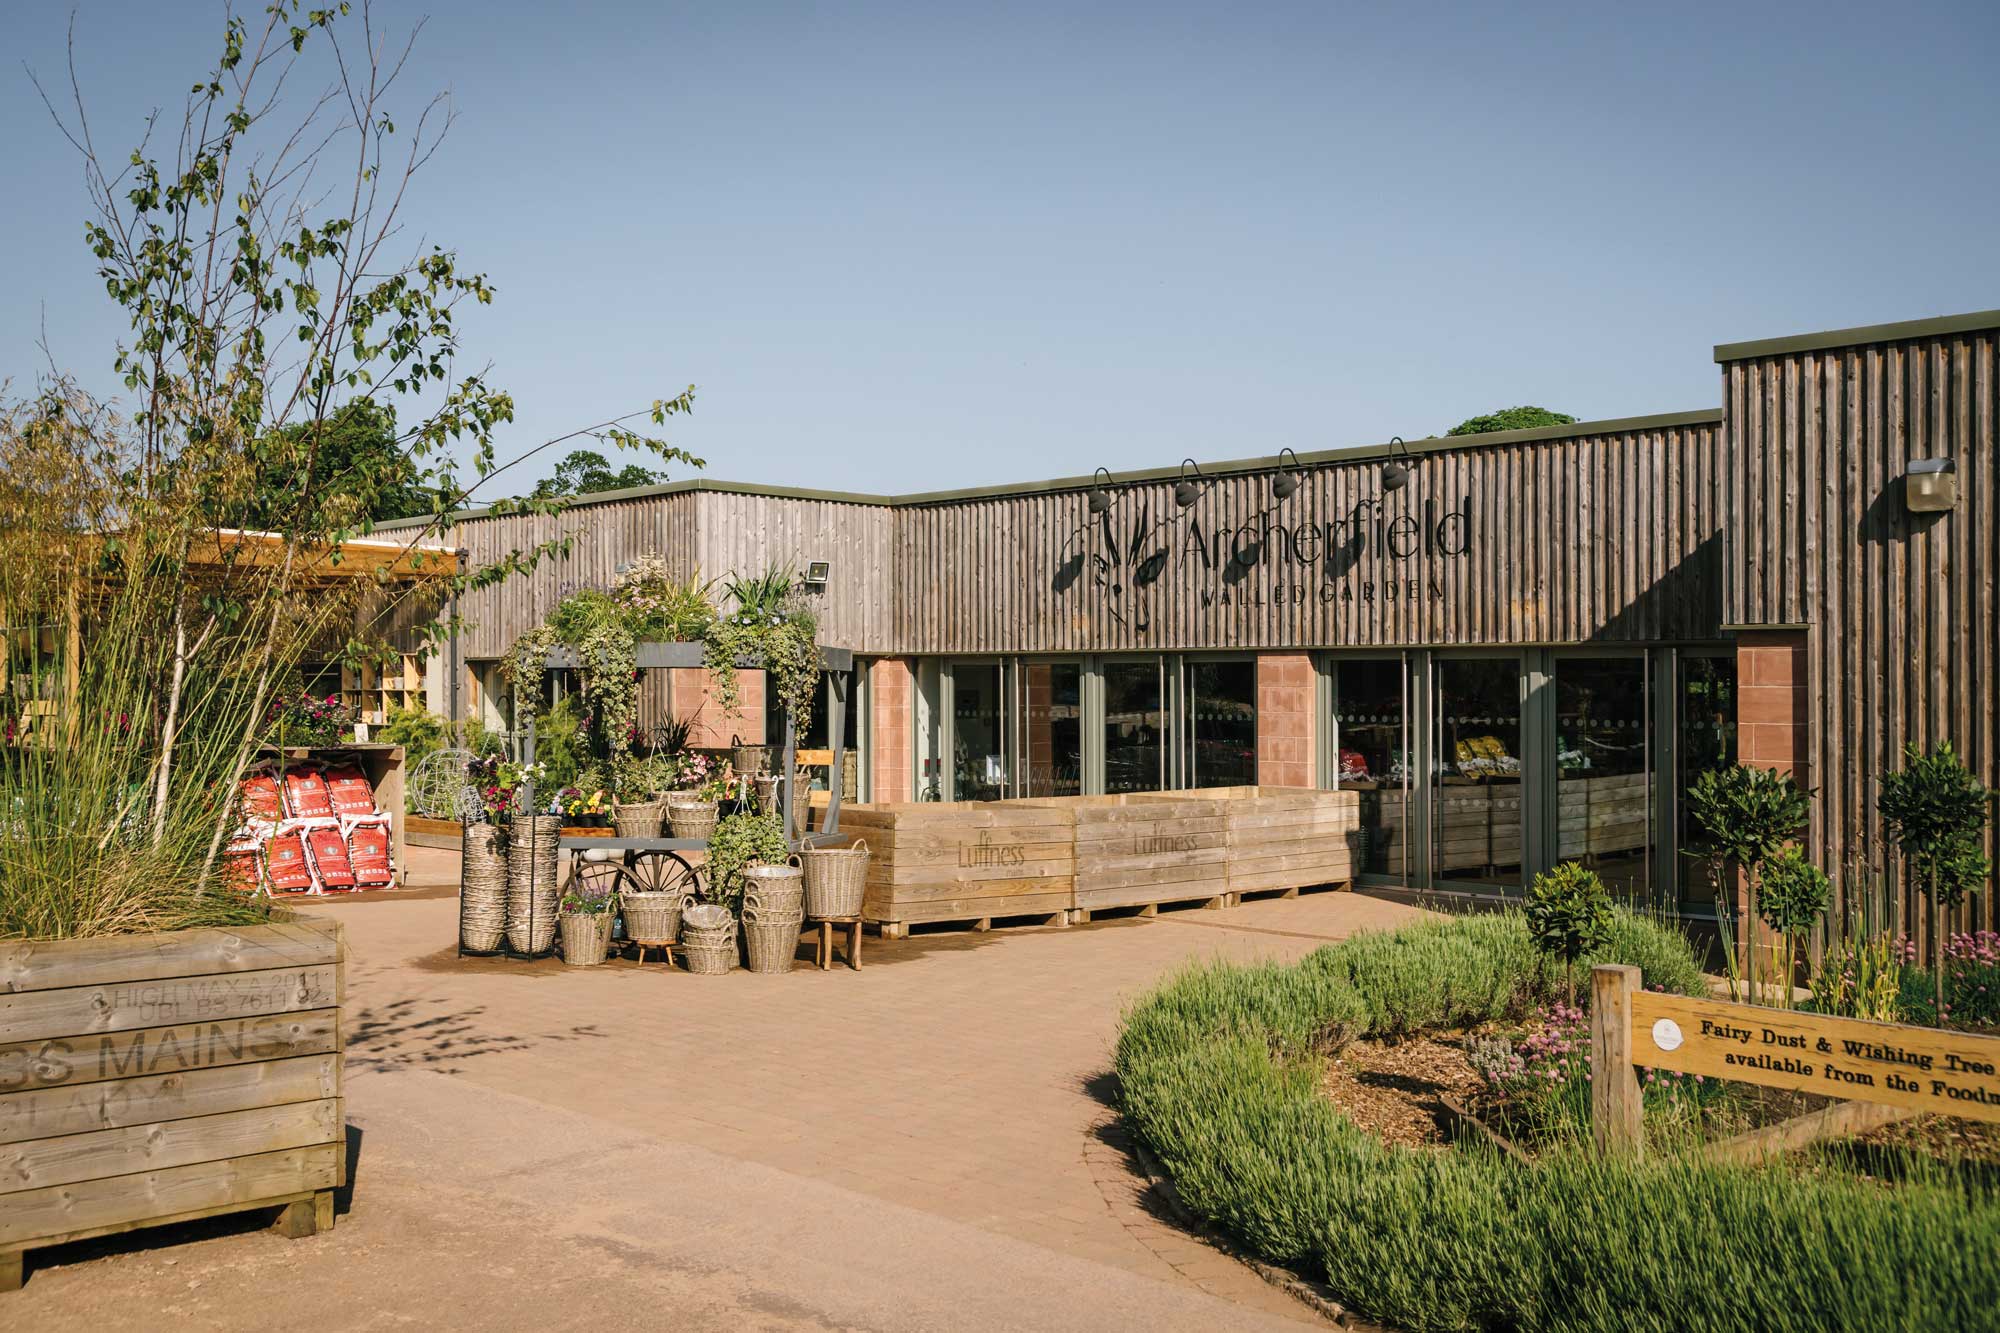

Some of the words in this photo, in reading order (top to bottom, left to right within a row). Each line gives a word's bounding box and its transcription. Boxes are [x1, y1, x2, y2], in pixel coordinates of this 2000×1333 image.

[1179, 496, 1472, 570] Archerfield
[1201, 584, 1306, 609] WALLED
[1319, 578, 1444, 603] GARDEN
[958, 830, 1025, 868] Luffness
[1700, 1019, 1753, 1044] Fairy
[1761, 1028, 1807, 1050] Dust
[1816, 1037, 1832, 1052] &
[1842, 1039, 1934, 1071] Wishing
[1945, 1053, 1996, 1076] Tree
[1725, 1051, 1814, 1077] available
[1823, 1064, 1876, 1087] from
[1885, 1074, 1920, 1093] the
